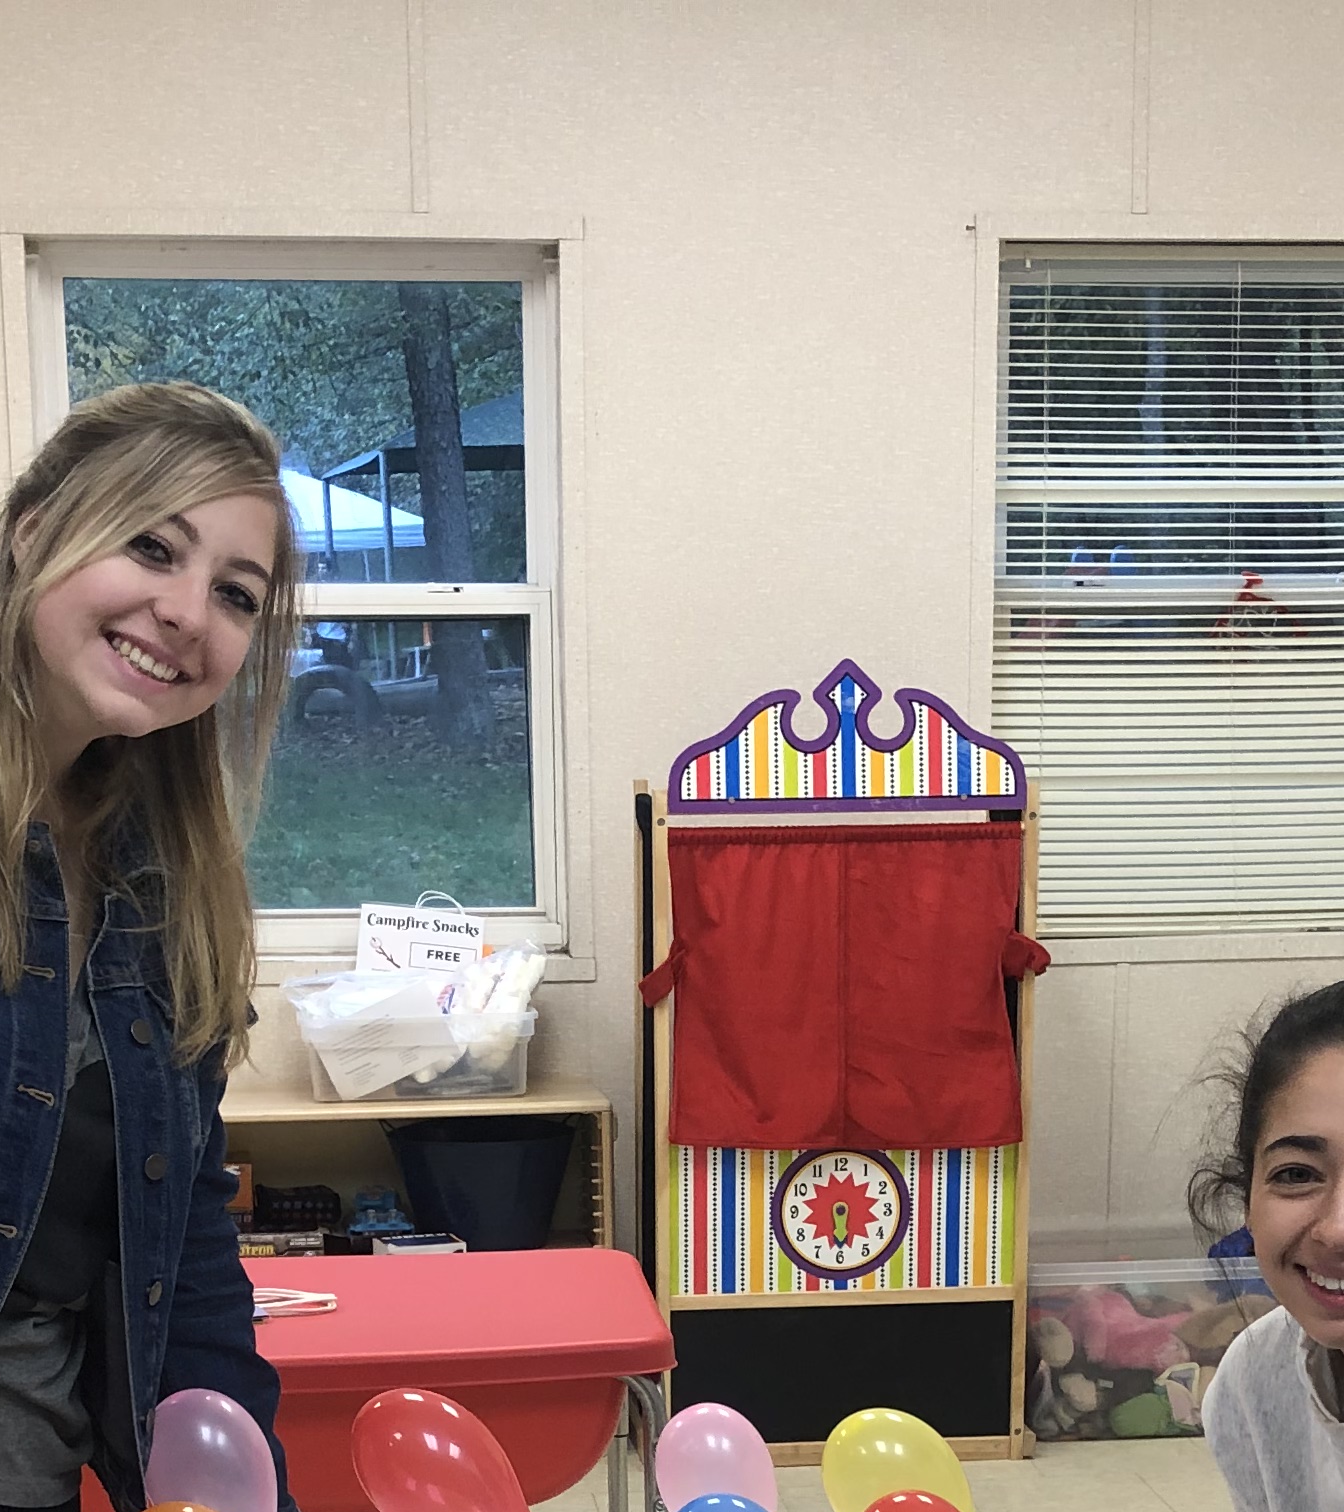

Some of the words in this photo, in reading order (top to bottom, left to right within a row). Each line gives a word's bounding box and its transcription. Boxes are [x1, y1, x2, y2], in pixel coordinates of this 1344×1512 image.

[367, 913, 430, 931] Campfire
[432, 920, 480, 938] Snacks
[427, 949, 462, 962] FREE
[812, 1164, 822, 1177] 11
[834, 1158, 848, 1172] 12
[863, 1163, 868, 1176] 1
[793, 1183, 807, 1197] 10
[879, 1181, 887, 1194] 2
[790, 1205, 799, 1218] 9
[883, 1203, 892, 1216] 3
[797, 1228, 805, 1241] 8
[876, 1226, 884, 1239] 4
[814, 1245, 822, 1259] 7
[861, 1243, 870, 1257] 5
[836, 1251, 844, 1264] 6
